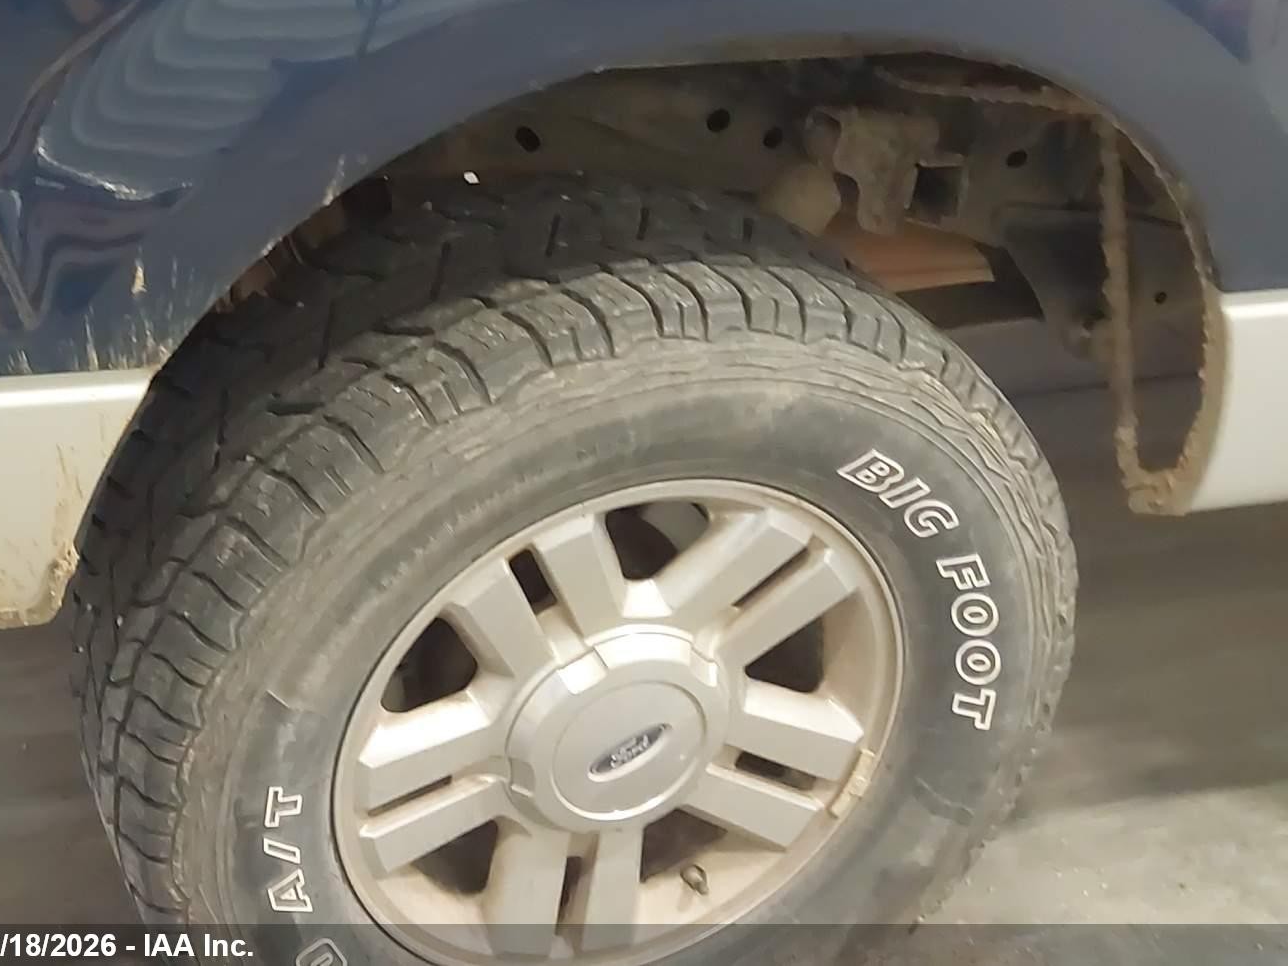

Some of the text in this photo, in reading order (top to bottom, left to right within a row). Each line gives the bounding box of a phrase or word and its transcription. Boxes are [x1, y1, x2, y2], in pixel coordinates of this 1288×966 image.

[837, 448, 1002, 731] BIG FOOT
[263, 786, 313, 912] A/T
